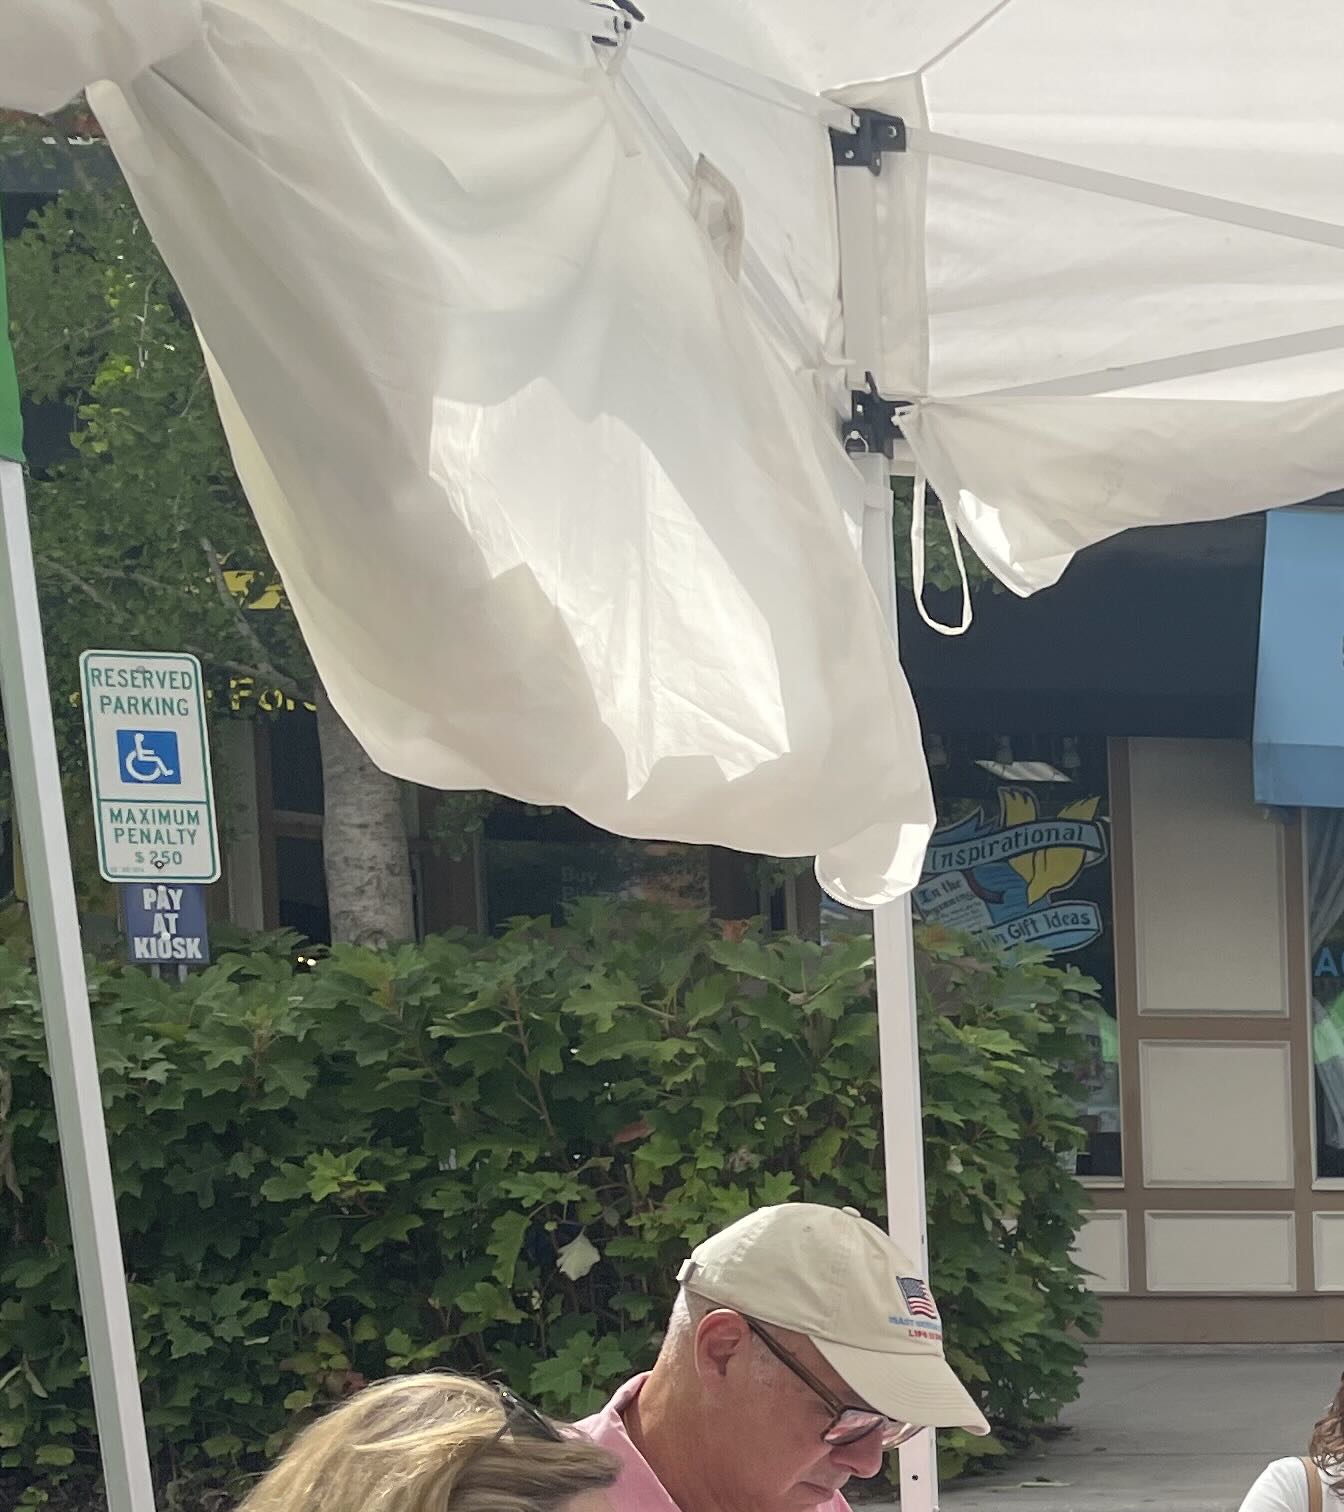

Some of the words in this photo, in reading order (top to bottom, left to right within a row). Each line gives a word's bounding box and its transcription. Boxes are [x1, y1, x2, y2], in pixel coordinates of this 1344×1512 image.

[90, 667, 193, 691] RESERVED
[100, 696, 190, 717] PARKING
[109, 808, 200, 826] MAXIMUM
[114, 827, 197, 846] PENALTY
[931, 824, 1085, 871] Inspirational
[143, 888, 183, 911] PAY
[152, 912, 178, 936] AT
[1007, 916, 1040, 941] Gift
[1046, 911, 1091, 929] Ideas
[134, 937, 202, 960] KIOSK
